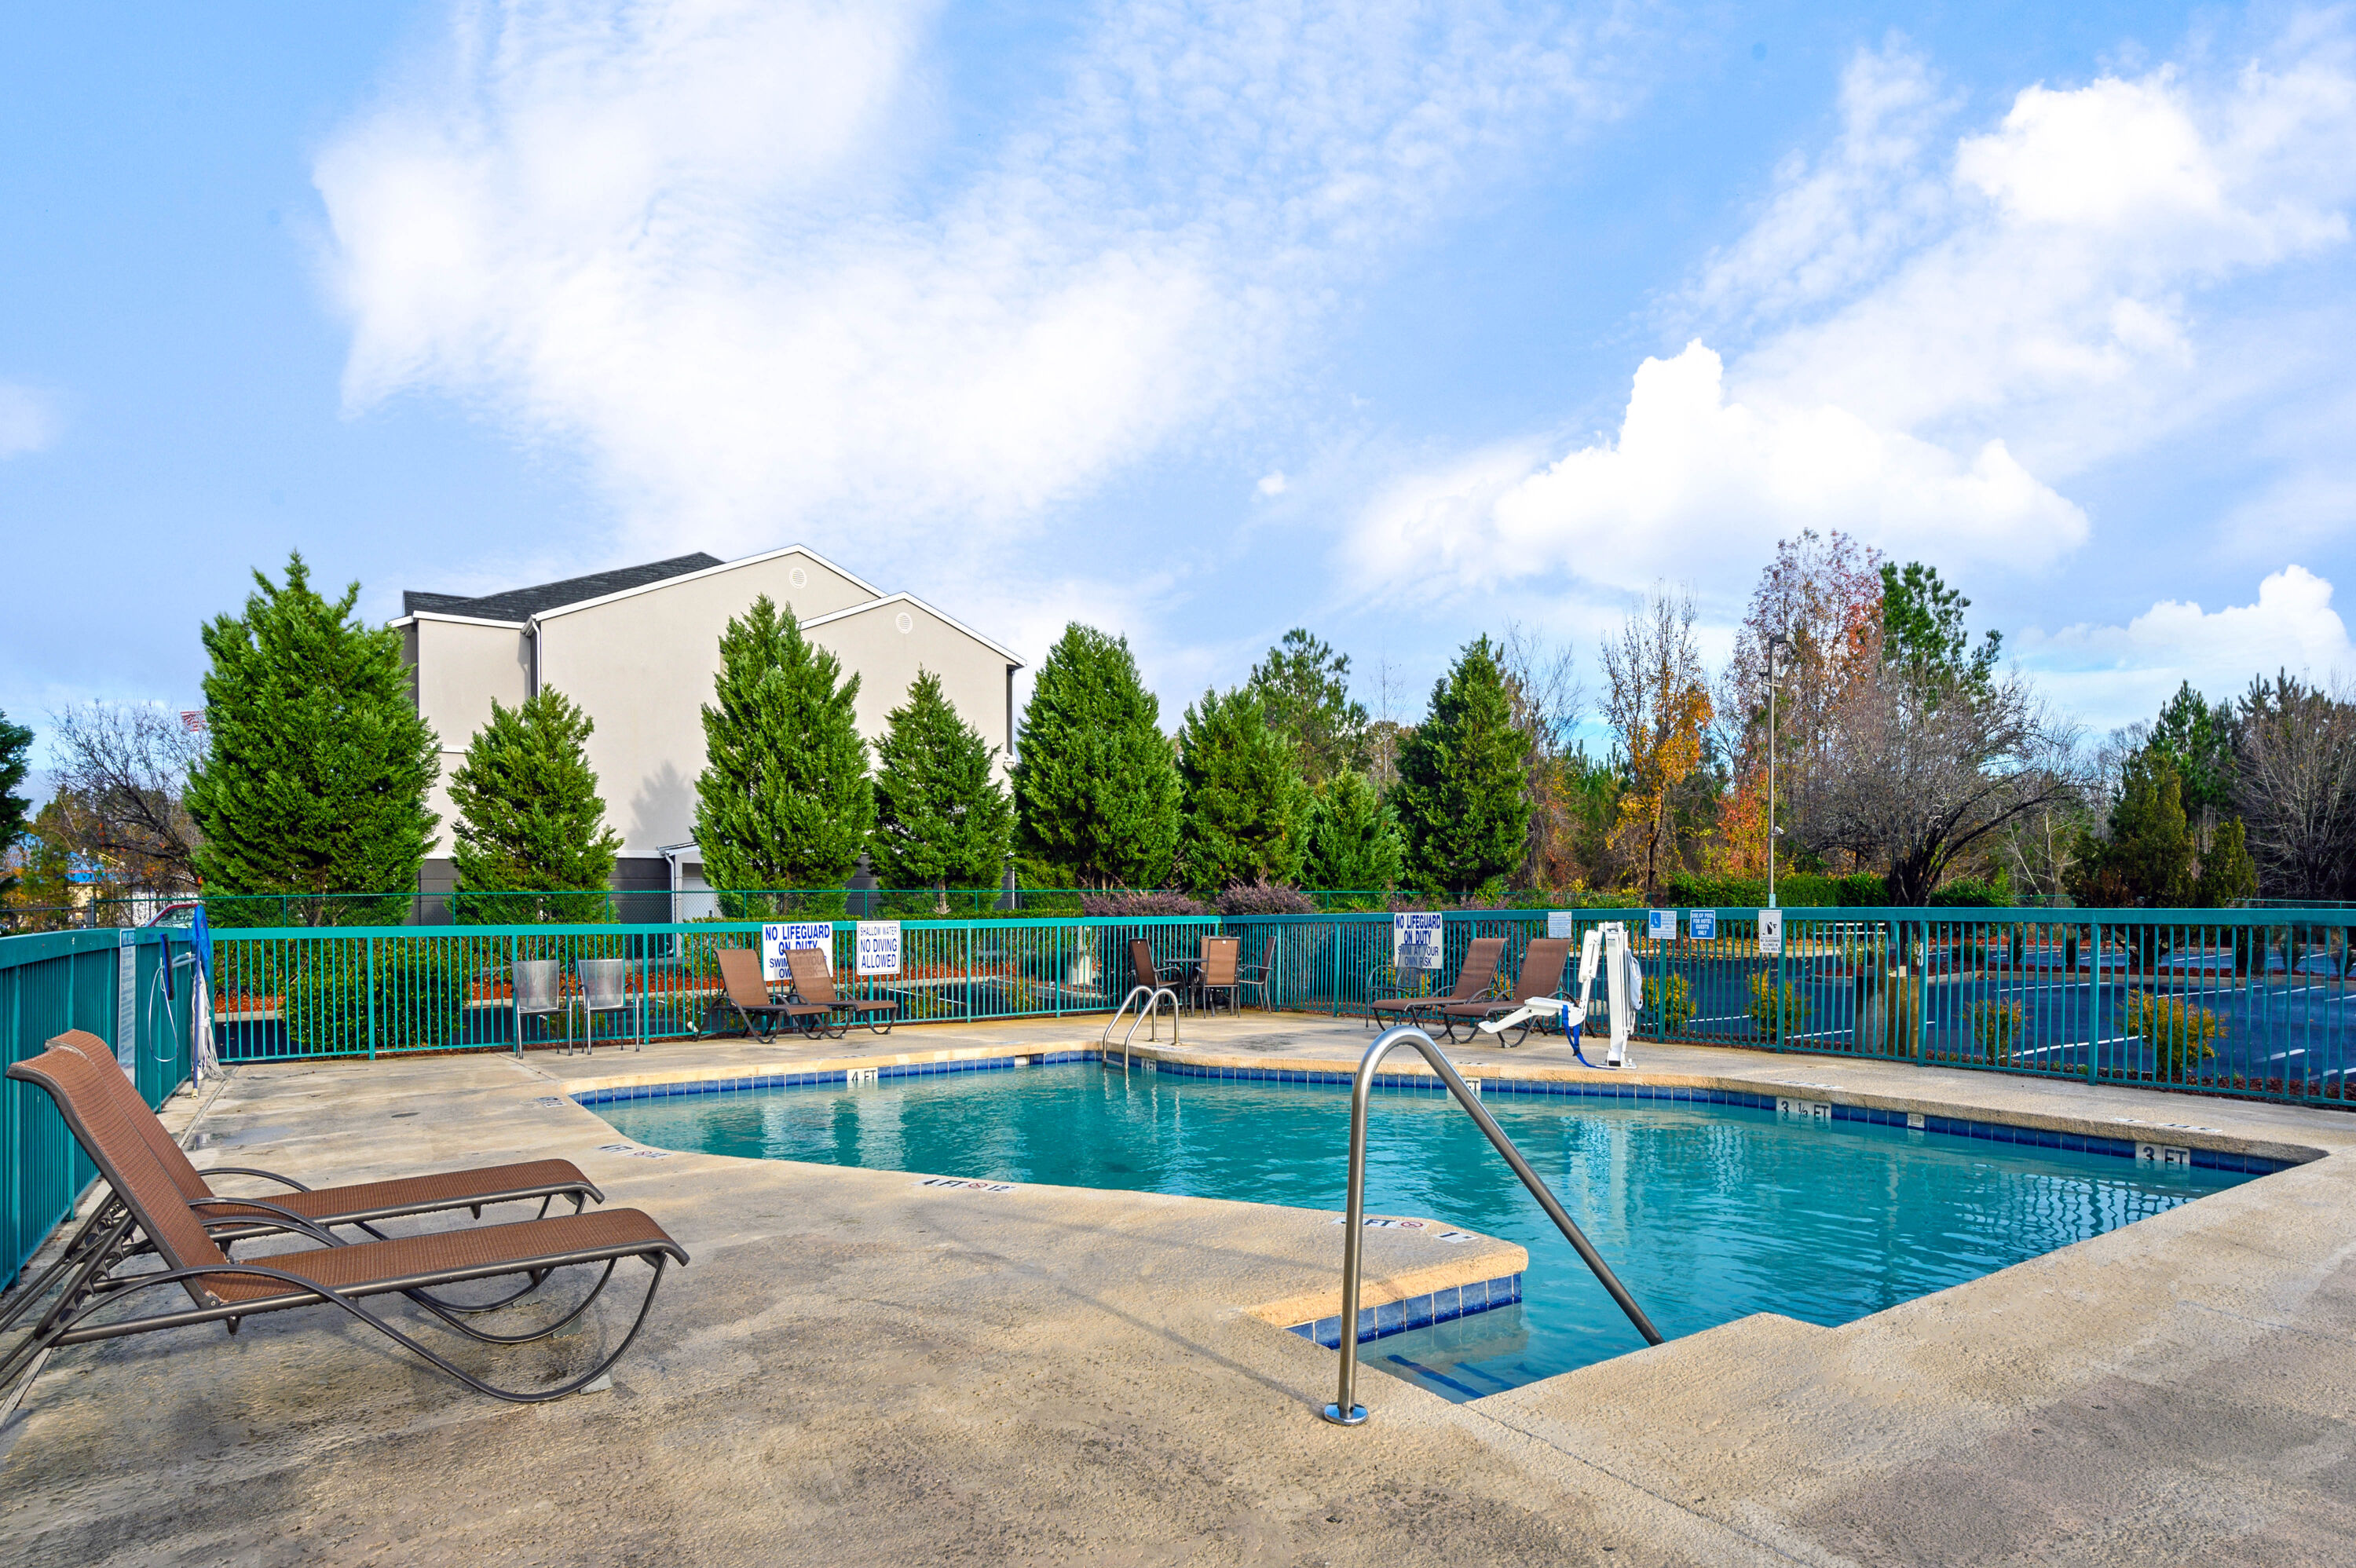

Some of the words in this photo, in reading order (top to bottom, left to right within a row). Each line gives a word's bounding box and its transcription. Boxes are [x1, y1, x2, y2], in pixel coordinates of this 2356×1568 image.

[1396, 915, 1404, 929] NO
[1407, 915, 1441, 929] LIFEGUARD
[766, 927, 777, 941] NO
[782, 925, 830, 940] LIFEGUARD
[860, 927, 880, 936] SHALLOW
[883, 927, 897, 935] WATER
[1404, 930, 1413, 944] ON
[1415, 930, 1432, 944] DUTY
[778, 941, 791, 956] ON
[860, 938, 871, 952] NO
[873, 938, 897, 952] DIVING
[862, 954, 896, 968] ALLOWED
[779, 968, 792, 978] OW
[851, 1071, 858, 1080] 4
[864, 1069, 876, 1080] FT
[1781, 1100, 1789, 1113] 3
[1813, 1104, 1829, 1117] FT
[2142, 1146, 2154, 1160] 3
[2164, 1148, 2187, 1164] FT
